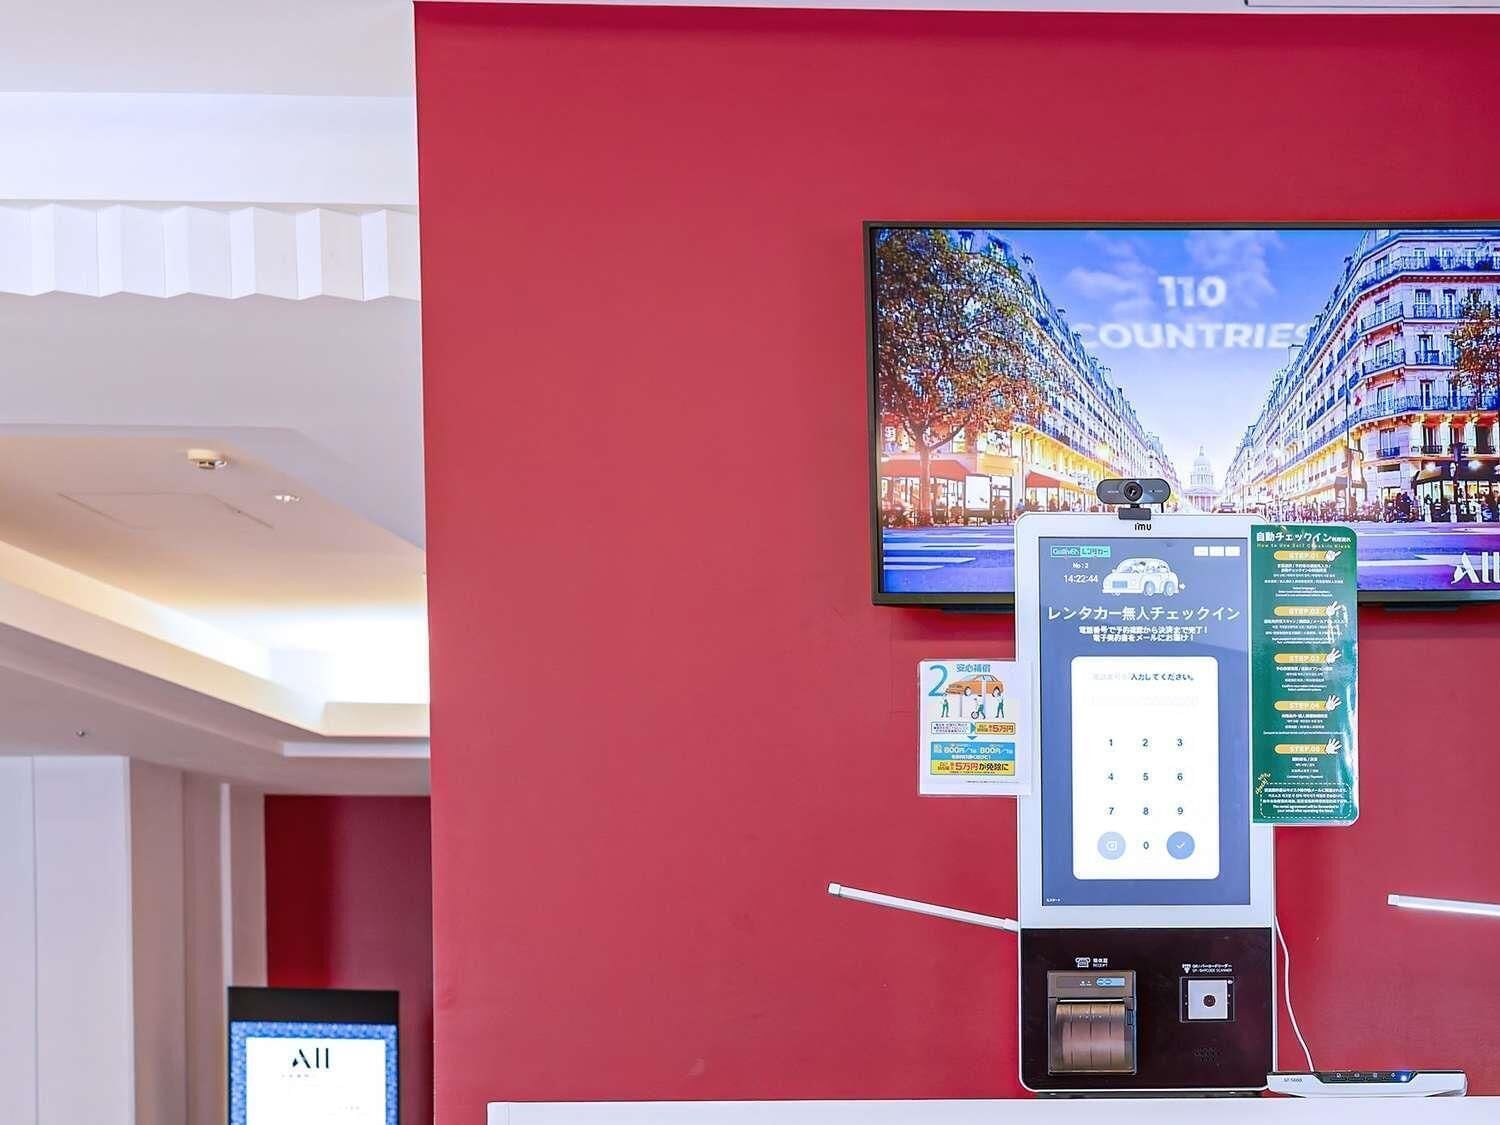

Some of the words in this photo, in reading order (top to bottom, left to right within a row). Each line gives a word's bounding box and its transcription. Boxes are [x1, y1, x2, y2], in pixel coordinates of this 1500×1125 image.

[1158, 276, 1227, 307] 110
[1064, 574, 1099, 583] 14:22:44
[1048, 606, 1240, 621] レンタカー無人チェックイン
[928, 665, 948, 696] 2
